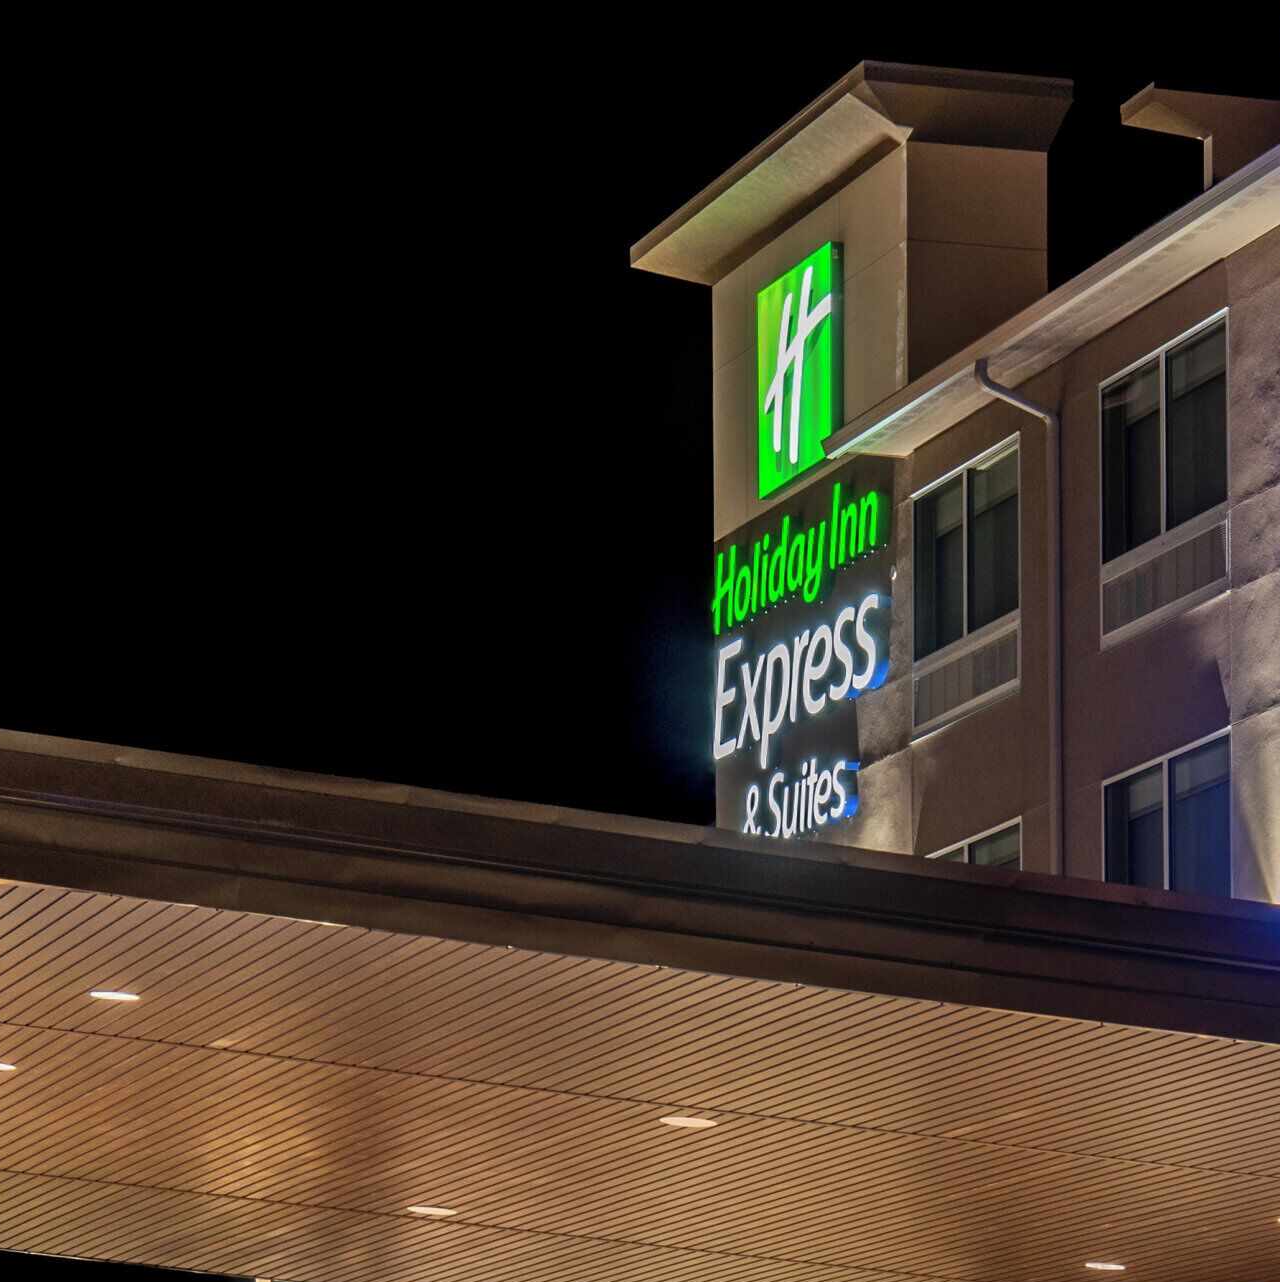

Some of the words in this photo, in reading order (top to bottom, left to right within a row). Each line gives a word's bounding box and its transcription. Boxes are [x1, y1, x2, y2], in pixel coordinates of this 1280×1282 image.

[711, 514, 826, 636] Holiday
[829, 482, 879, 570] Inn
[713, 593, 879, 770] Express
[743, 784, 762, 834] &
[764, 757, 846, 839] Suites
